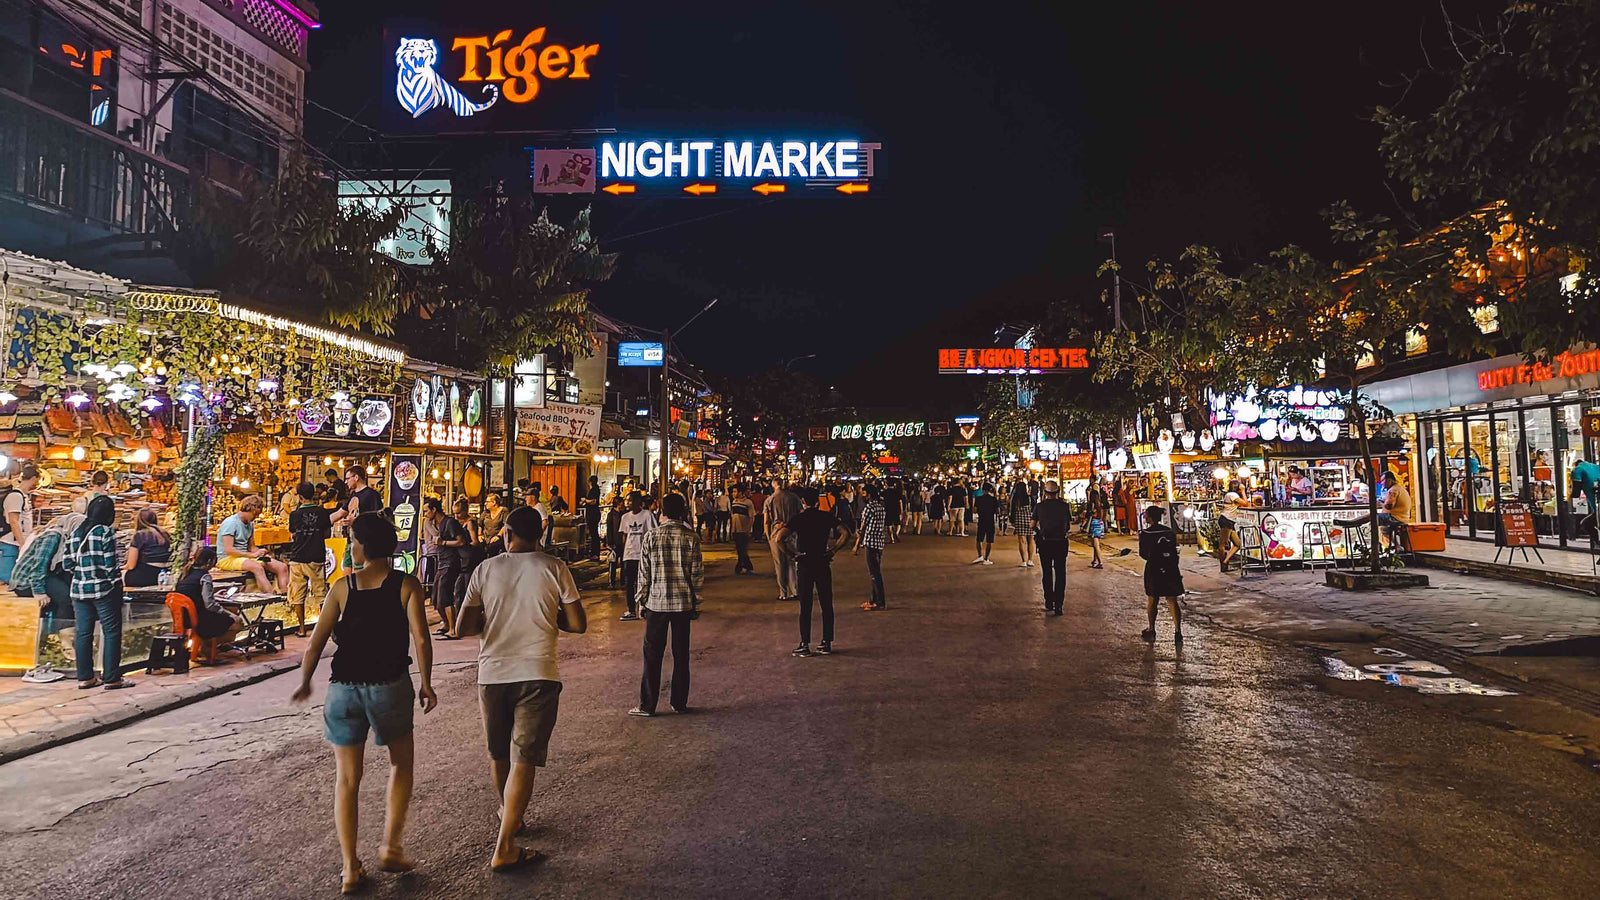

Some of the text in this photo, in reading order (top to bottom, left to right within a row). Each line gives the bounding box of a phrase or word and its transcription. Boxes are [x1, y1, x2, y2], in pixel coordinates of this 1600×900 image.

[452, 26, 600, 103] Tiger
[601, 141, 882, 177] NIGHT MARKET
[1478, 366, 1515, 390] DUTY
[519, 410, 551, 422] Seafood
[552, 415, 569, 425] BBQ
[1313, 406, 1345, 421] Rolls
[831, 422, 924, 440] PUB STREET
[1281, 512, 1320, 521] ROLLABILITY
[1321, 512, 1332, 520] ICE
[1333, 511, 1355, 520] CREAM
